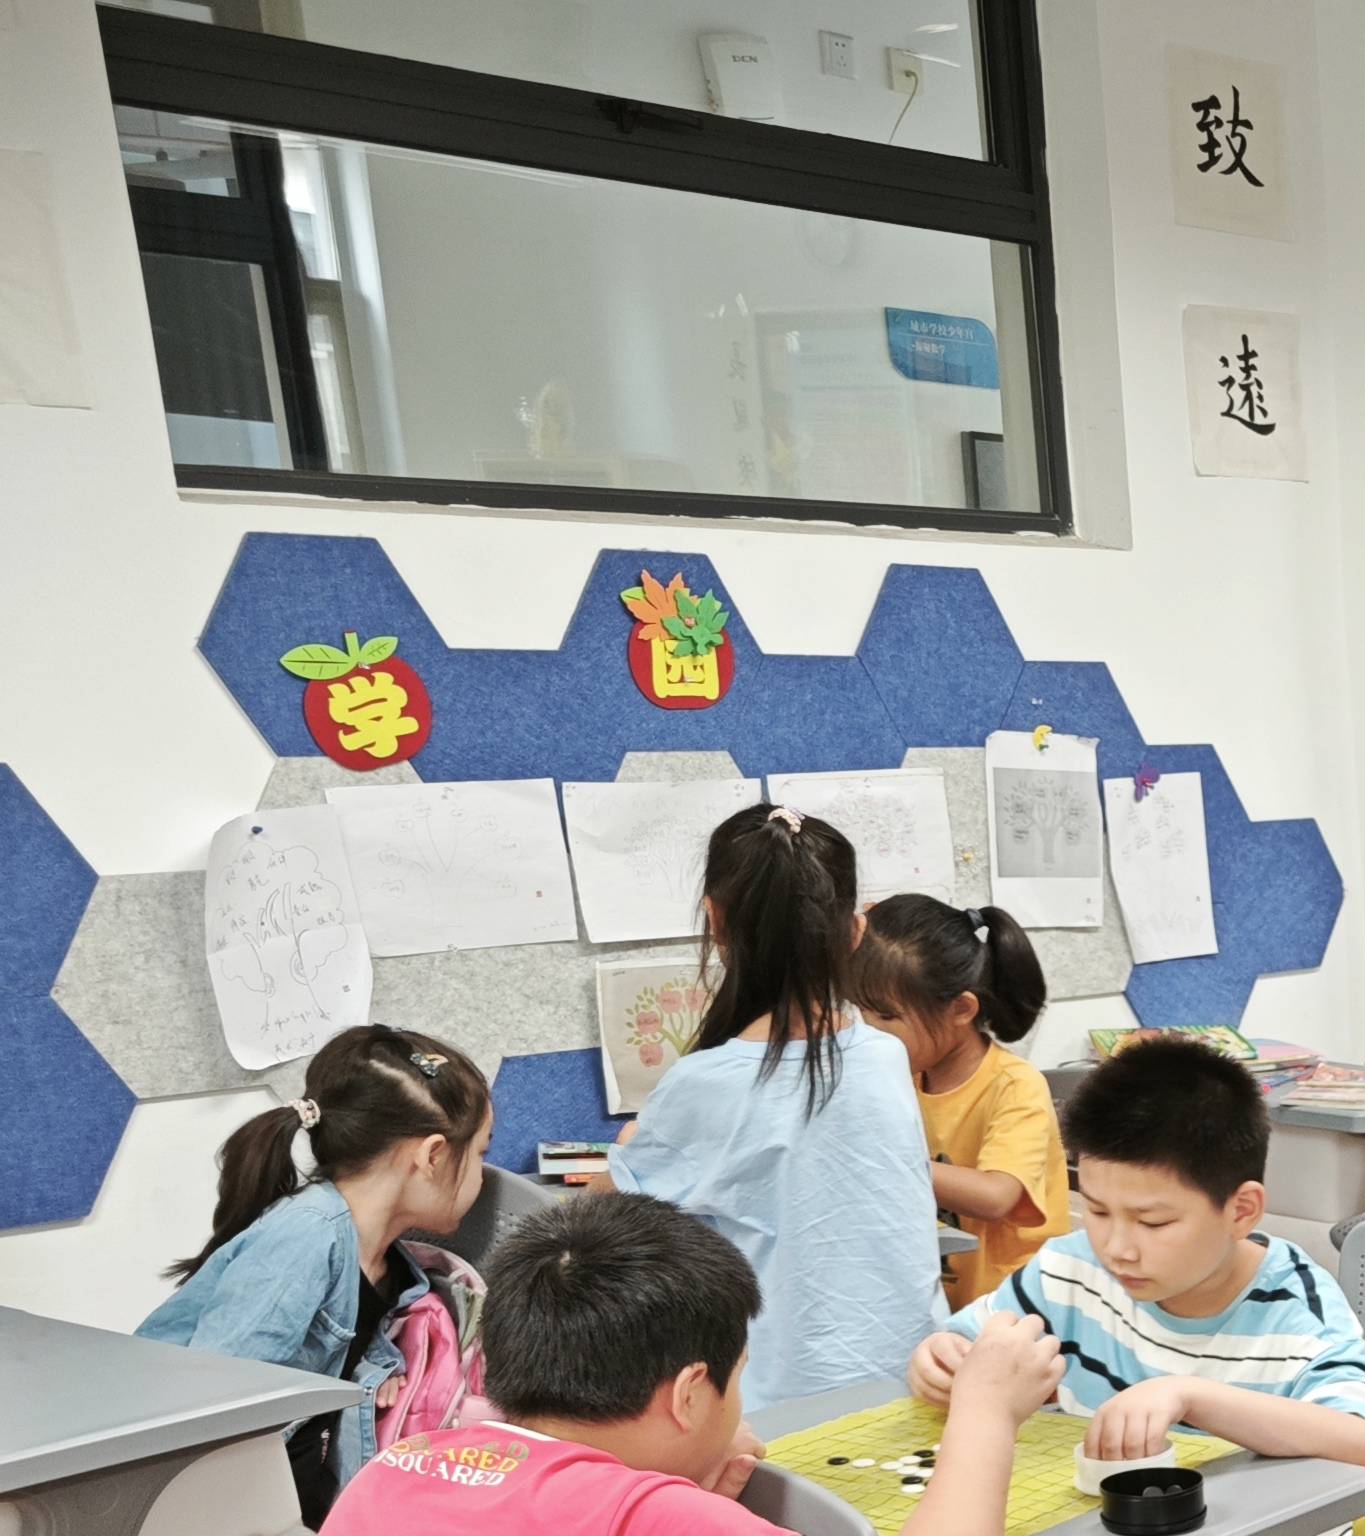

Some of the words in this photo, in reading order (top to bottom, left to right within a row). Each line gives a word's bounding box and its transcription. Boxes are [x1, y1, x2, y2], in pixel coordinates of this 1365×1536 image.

[1191, 84, 1265, 188] 致
[1217, 333, 1276, 437] 遠
[327, 671, 420, 759] 学
